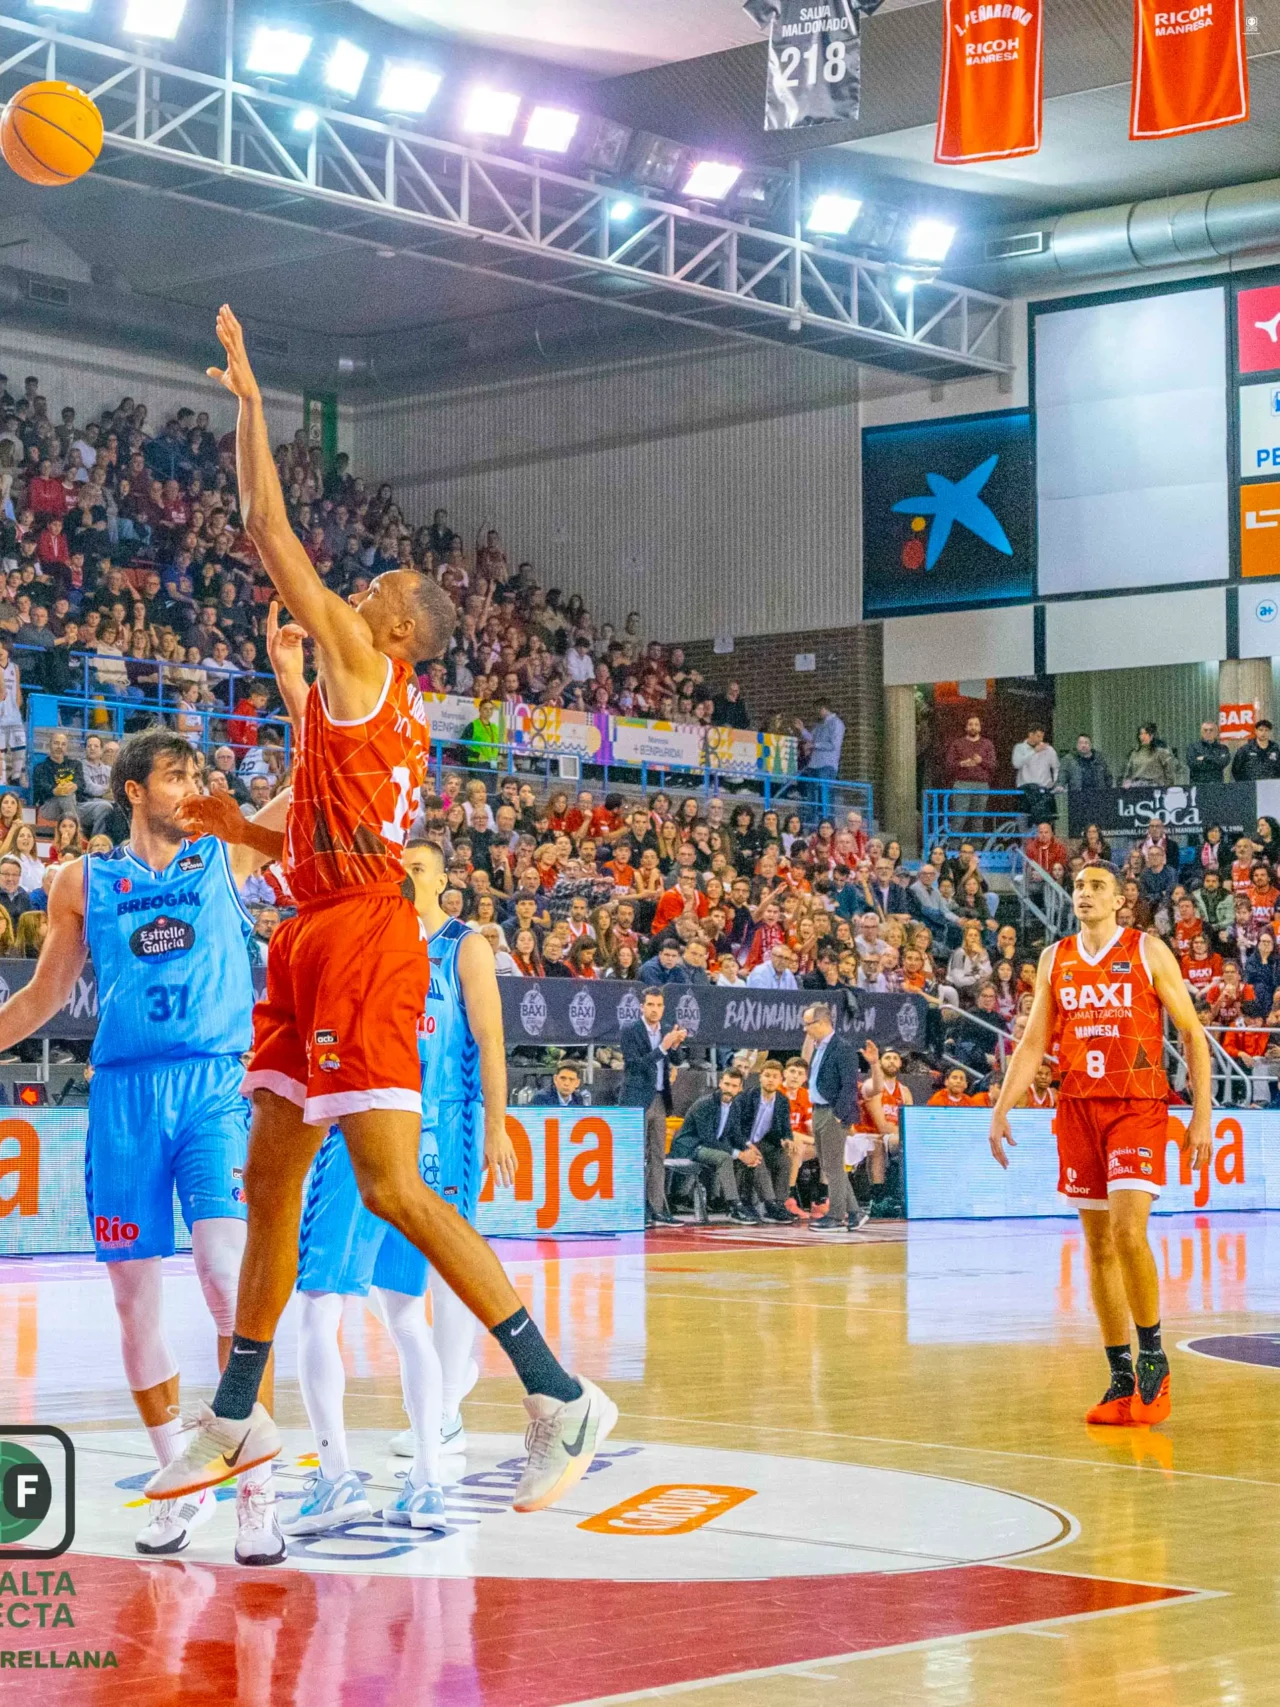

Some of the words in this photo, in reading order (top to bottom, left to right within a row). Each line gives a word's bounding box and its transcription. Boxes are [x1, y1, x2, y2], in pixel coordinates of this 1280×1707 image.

[800, 5, 831, 21] SALVA
[1155, 3, 1213, 26] RICOH
[782, 17, 849, 38] MALDONADO
[1155, 17, 1214, 36] MANRESA
[966, 37, 1019, 55] RICOH
[780, 41, 847, 87] 218
[966, 51, 1019, 66] MANRESA
[1219, 710, 1254, 726] BAR
[116, 888, 202, 916] BREOGÁN
[140, 925, 185, 943] Estrella
[142, 938, 185, 954] Galicia
[146, 983, 189, 1023] 37
[1060, 982, 1133, 1011] BAXI
[522, 1004, 546, 1017] BAXI
[570, 1005, 595, 1019] BAXI
[1074, 1024, 1120, 1039] MANRESA
[1086, 1050, 1105, 1079] 8
[95, 1215, 140, 1243] Río
